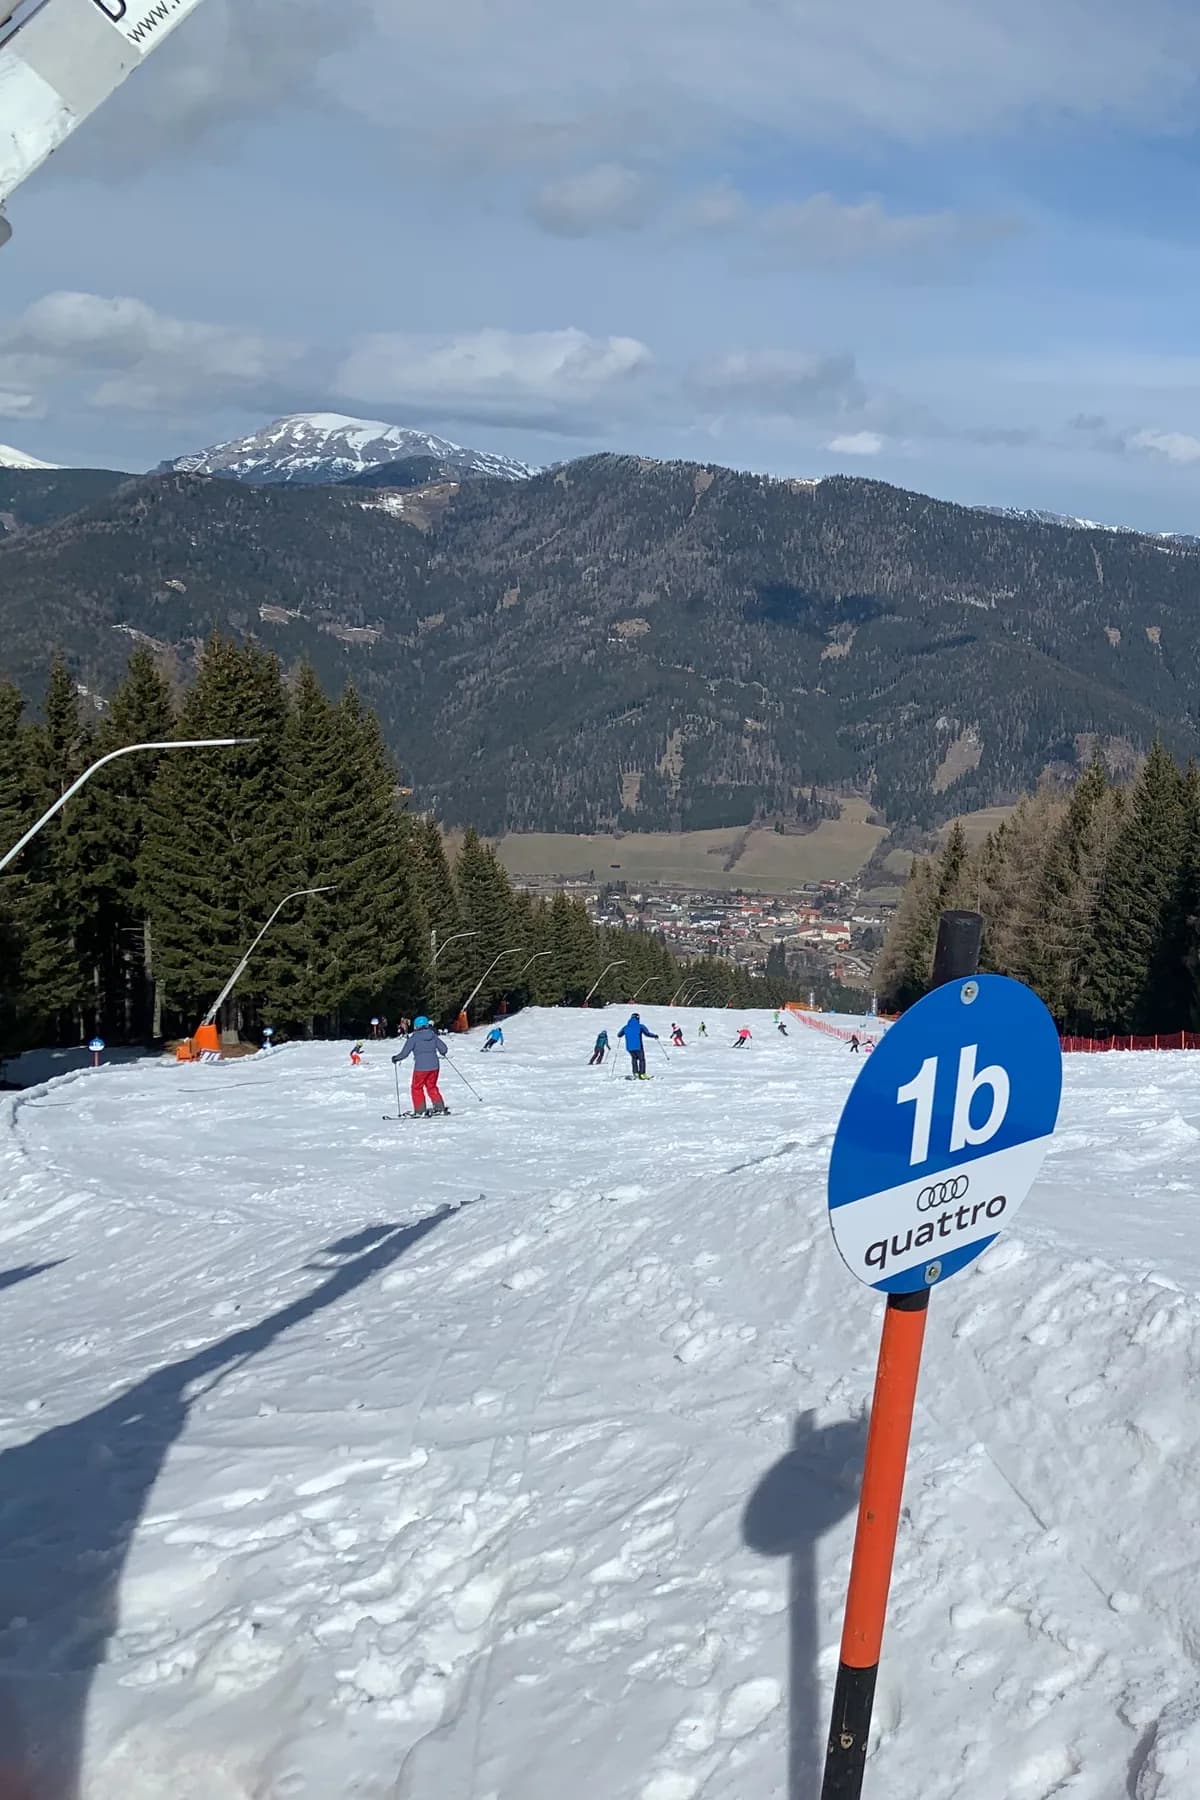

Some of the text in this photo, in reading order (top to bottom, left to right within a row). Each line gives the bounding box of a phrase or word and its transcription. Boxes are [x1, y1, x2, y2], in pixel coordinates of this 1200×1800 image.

[127, 0, 182, 43] www.
[896, 1043, 1011, 1167] 1b
[864, 1194, 1007, 1270] quattro
